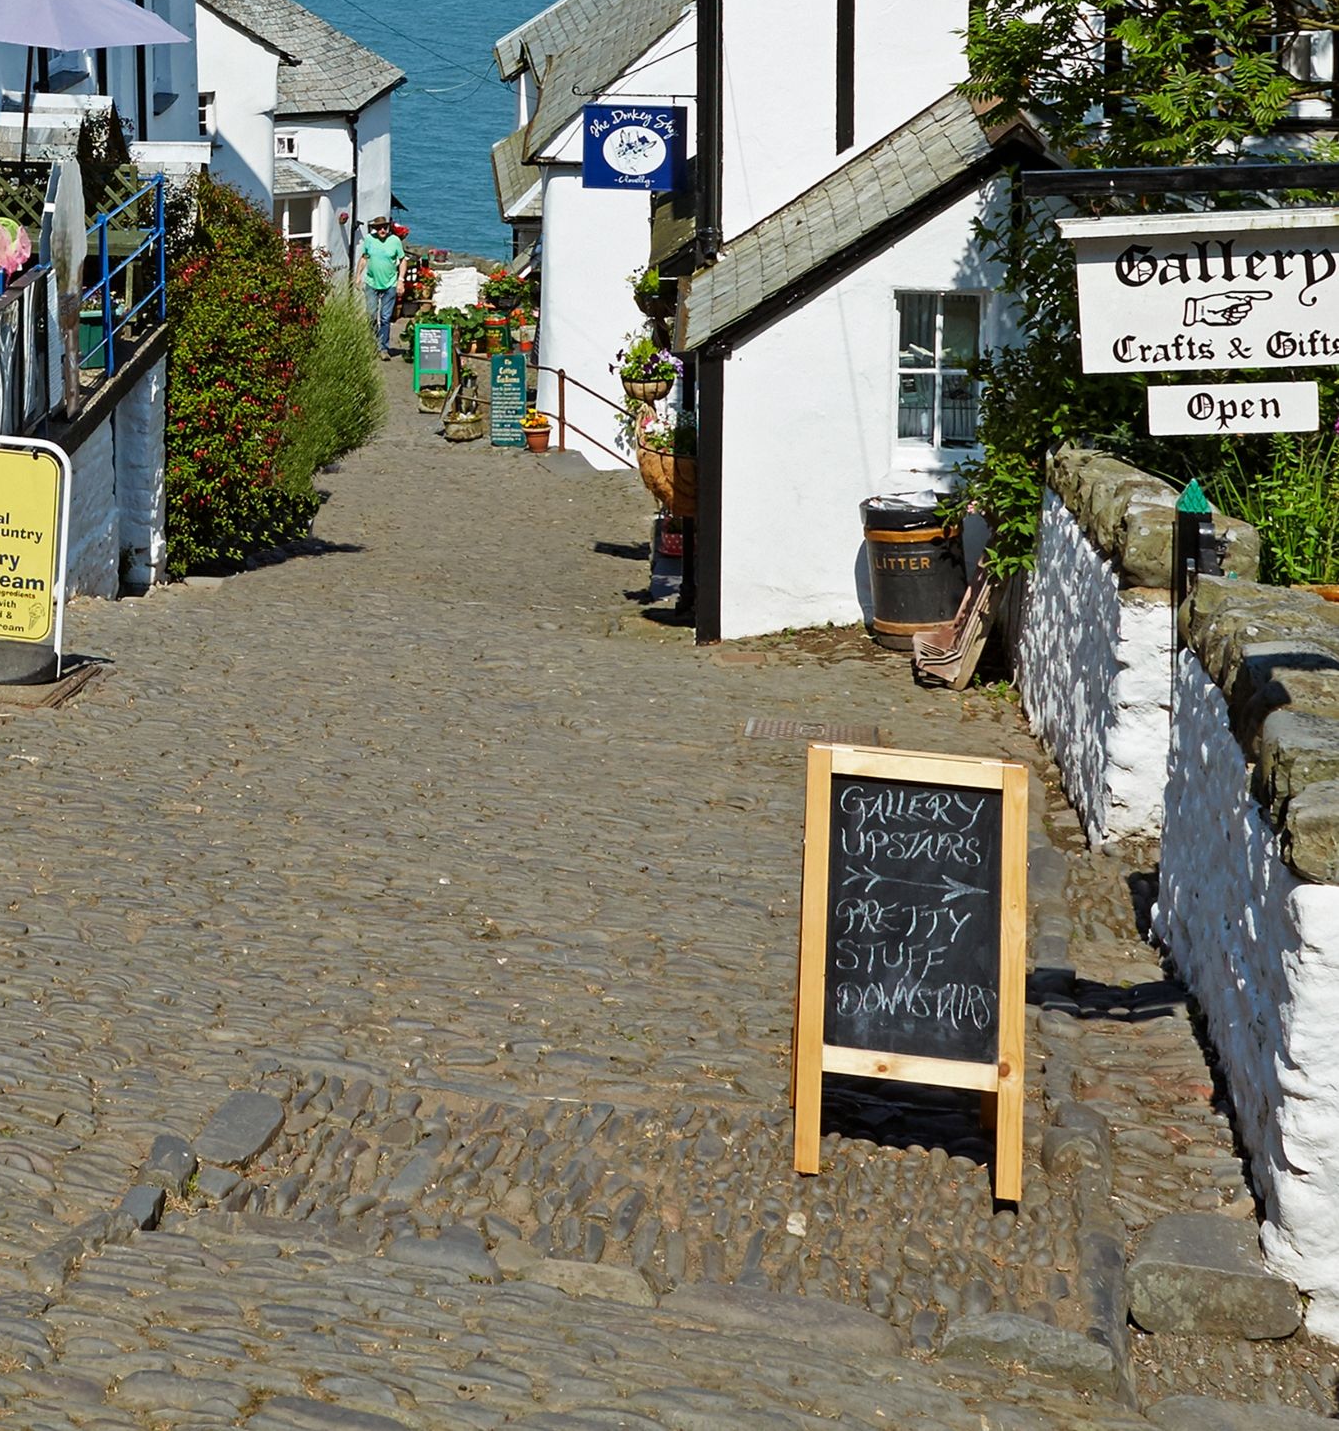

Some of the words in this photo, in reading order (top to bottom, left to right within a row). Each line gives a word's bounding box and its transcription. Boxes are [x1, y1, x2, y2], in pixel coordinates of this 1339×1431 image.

[590, 119, 609, 137] The
[612, 109, 652, 127] Donkey
[1115, 239, 1336, 306] Gallery
[1113, 334, 1215, 364] Crafts
[1228, 338, 1252, 359] &
[1266, 330, 1339, 359] Gifts
[1187, 392, 1280, 430] Open
[875, 557, 930, 569] LITTER
[840, 785, 985, 832] GALLERY
[841, 827, 981, 867] UPSTAIRS
[835, 899, 973, 943] PRETTY
[836, 939, 947, 989] STUFF
[836, 981, 997, 1030] DOWNSTAIRS
